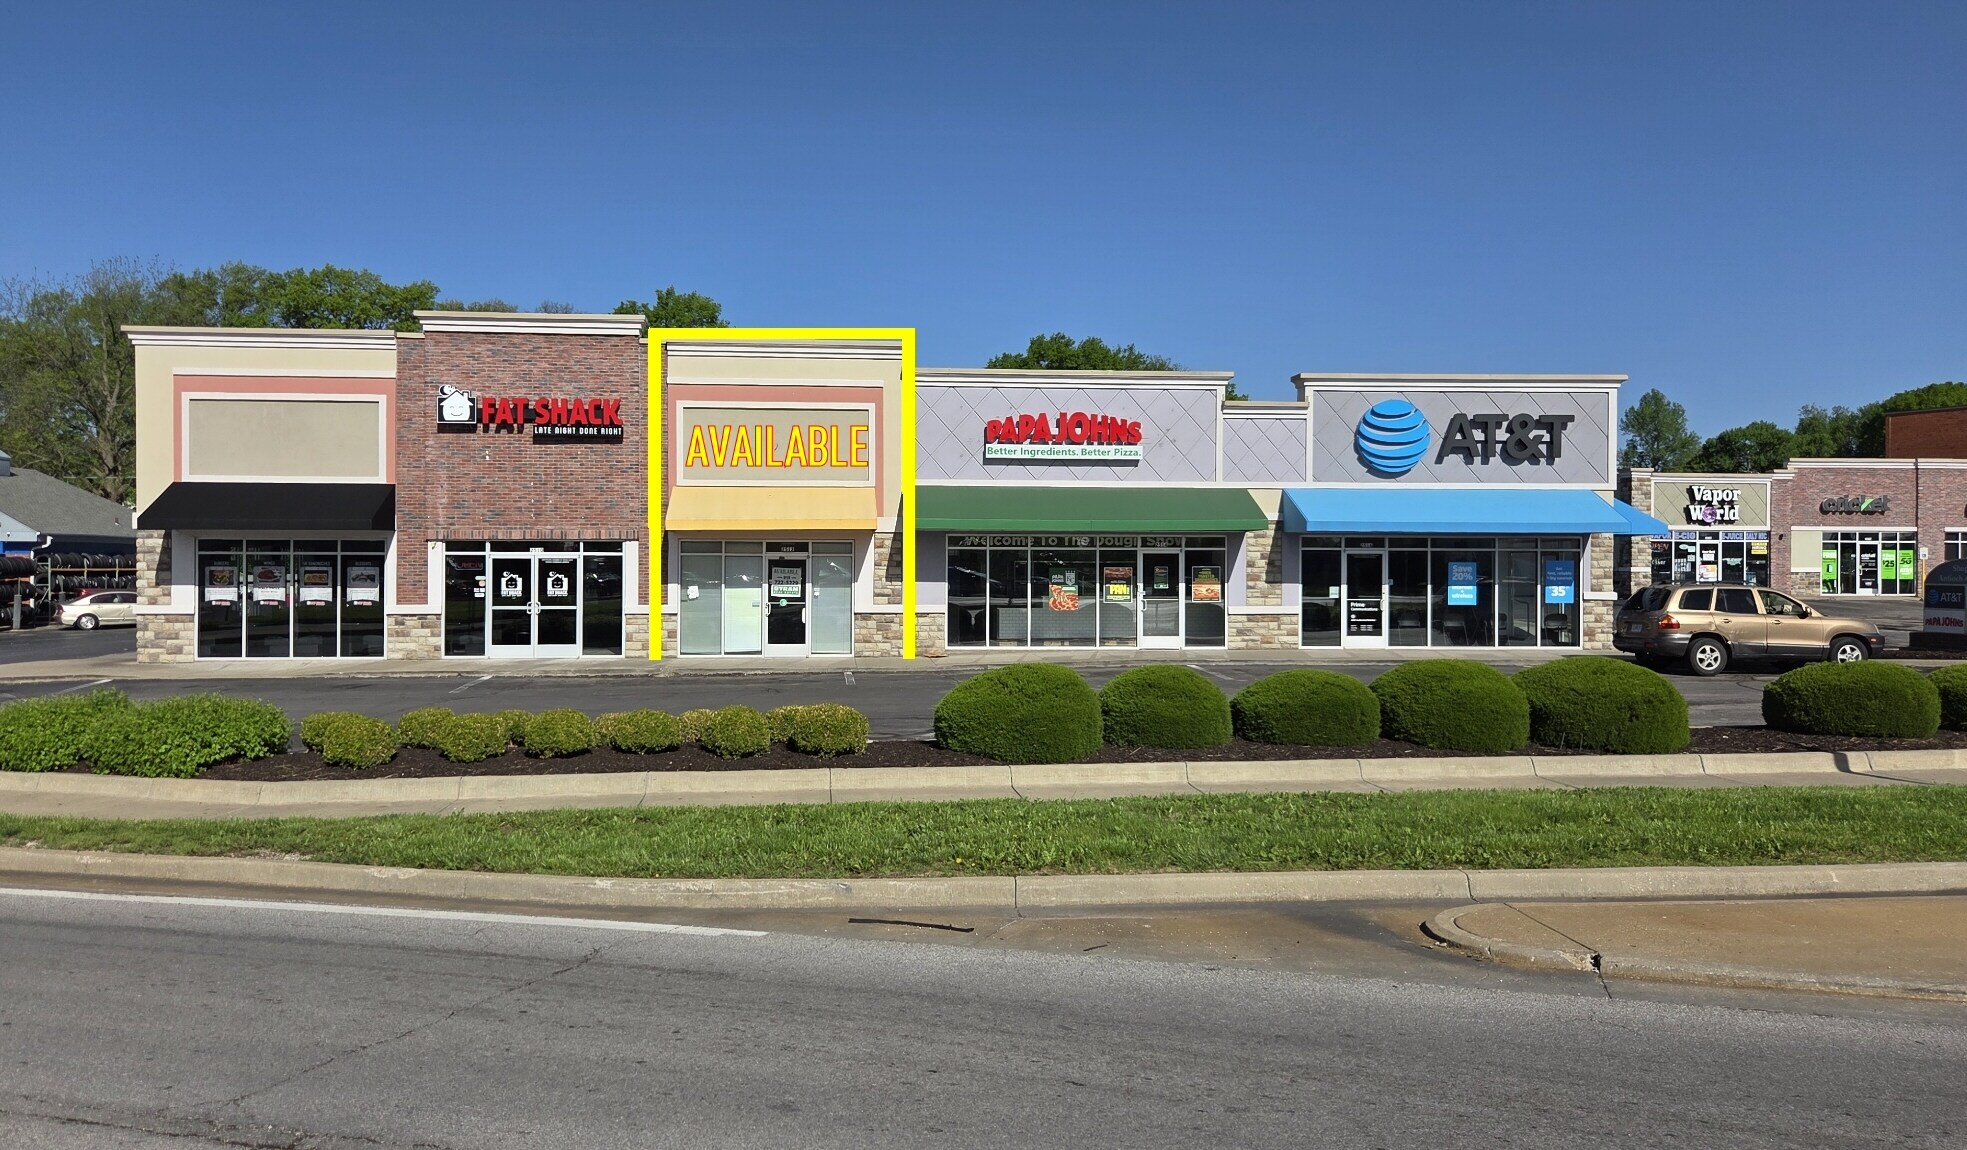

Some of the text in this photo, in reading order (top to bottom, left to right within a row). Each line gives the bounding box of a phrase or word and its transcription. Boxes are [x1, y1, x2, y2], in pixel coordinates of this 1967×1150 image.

[482, 397, 623, 426] FAT SHACK
[579, 427, 598, 435] DONE
[986, 411, 1142, 443] PAPA JOHNS
[1438, 413, 1575, 462] AT&T
[987, 446, 1142, 458] Better Ingredients. Better Pizza.
[1691, 486, 1741, 505] Vapor
[1821, 495, 1890, 514] cricket
[1688, 504, 1741, 523] World
[1452, 564, 1473, 573] Save
[1452, 572, 1473, 580] 20%
[1940, 592, 1963, 603] AT&T
[1925, 617, 1964, 628] PAPA JOHNS
